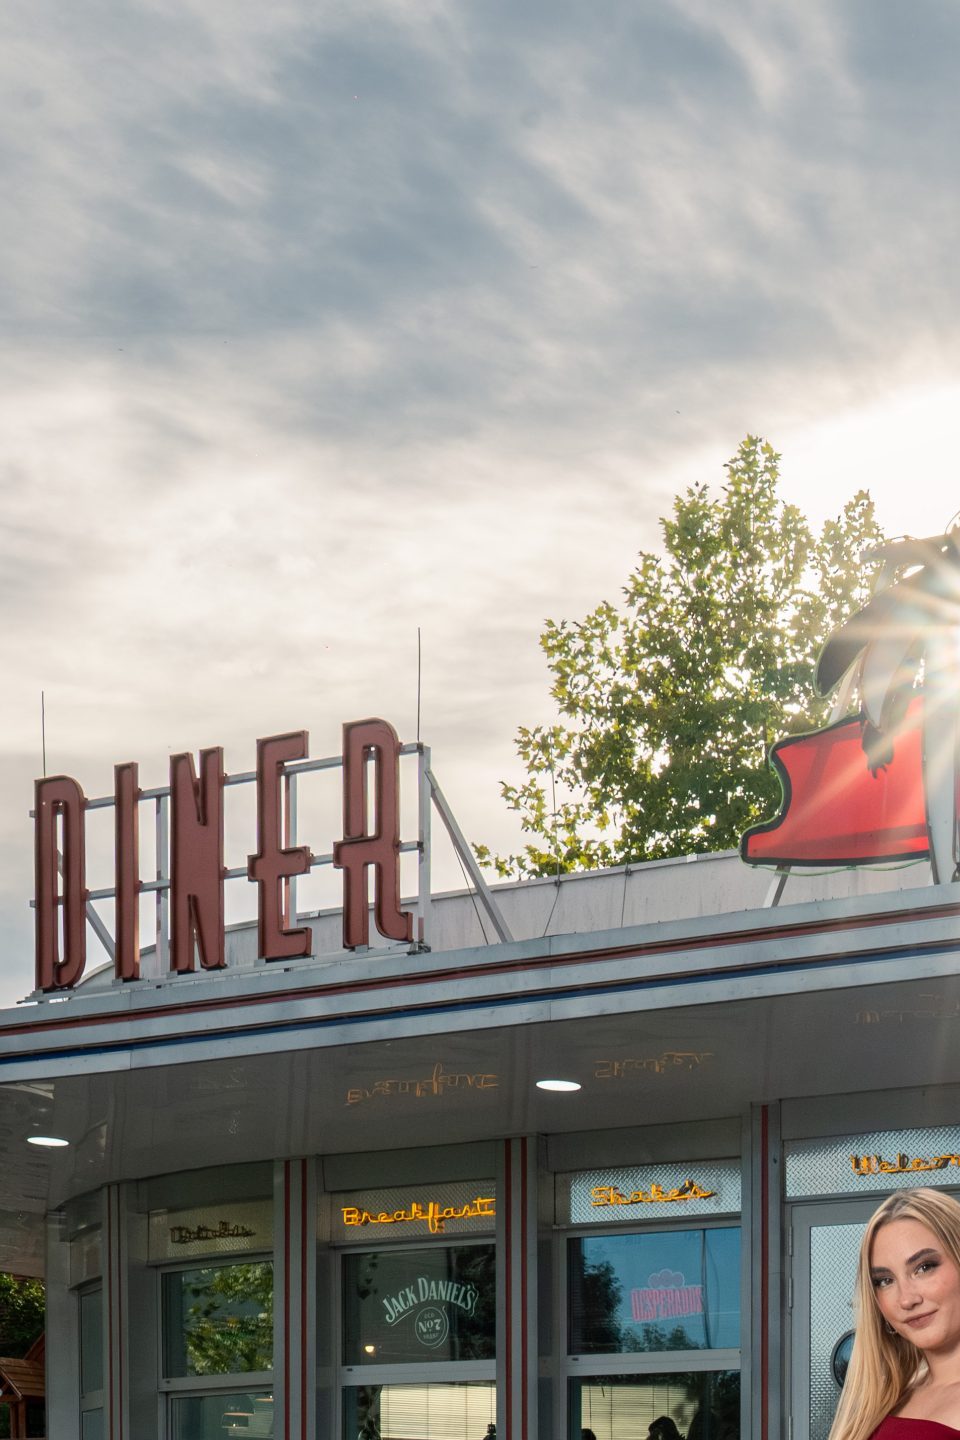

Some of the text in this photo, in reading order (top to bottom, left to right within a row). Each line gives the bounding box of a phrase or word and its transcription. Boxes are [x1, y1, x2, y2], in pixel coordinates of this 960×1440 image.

[34, 717, 413, 992] DINER
[591, 1179, 716, 1206] Shakes
[341, 1198, 496, 1233] Breakfast
[382, 1277, 475, 1323] JACK DANIEL'S
